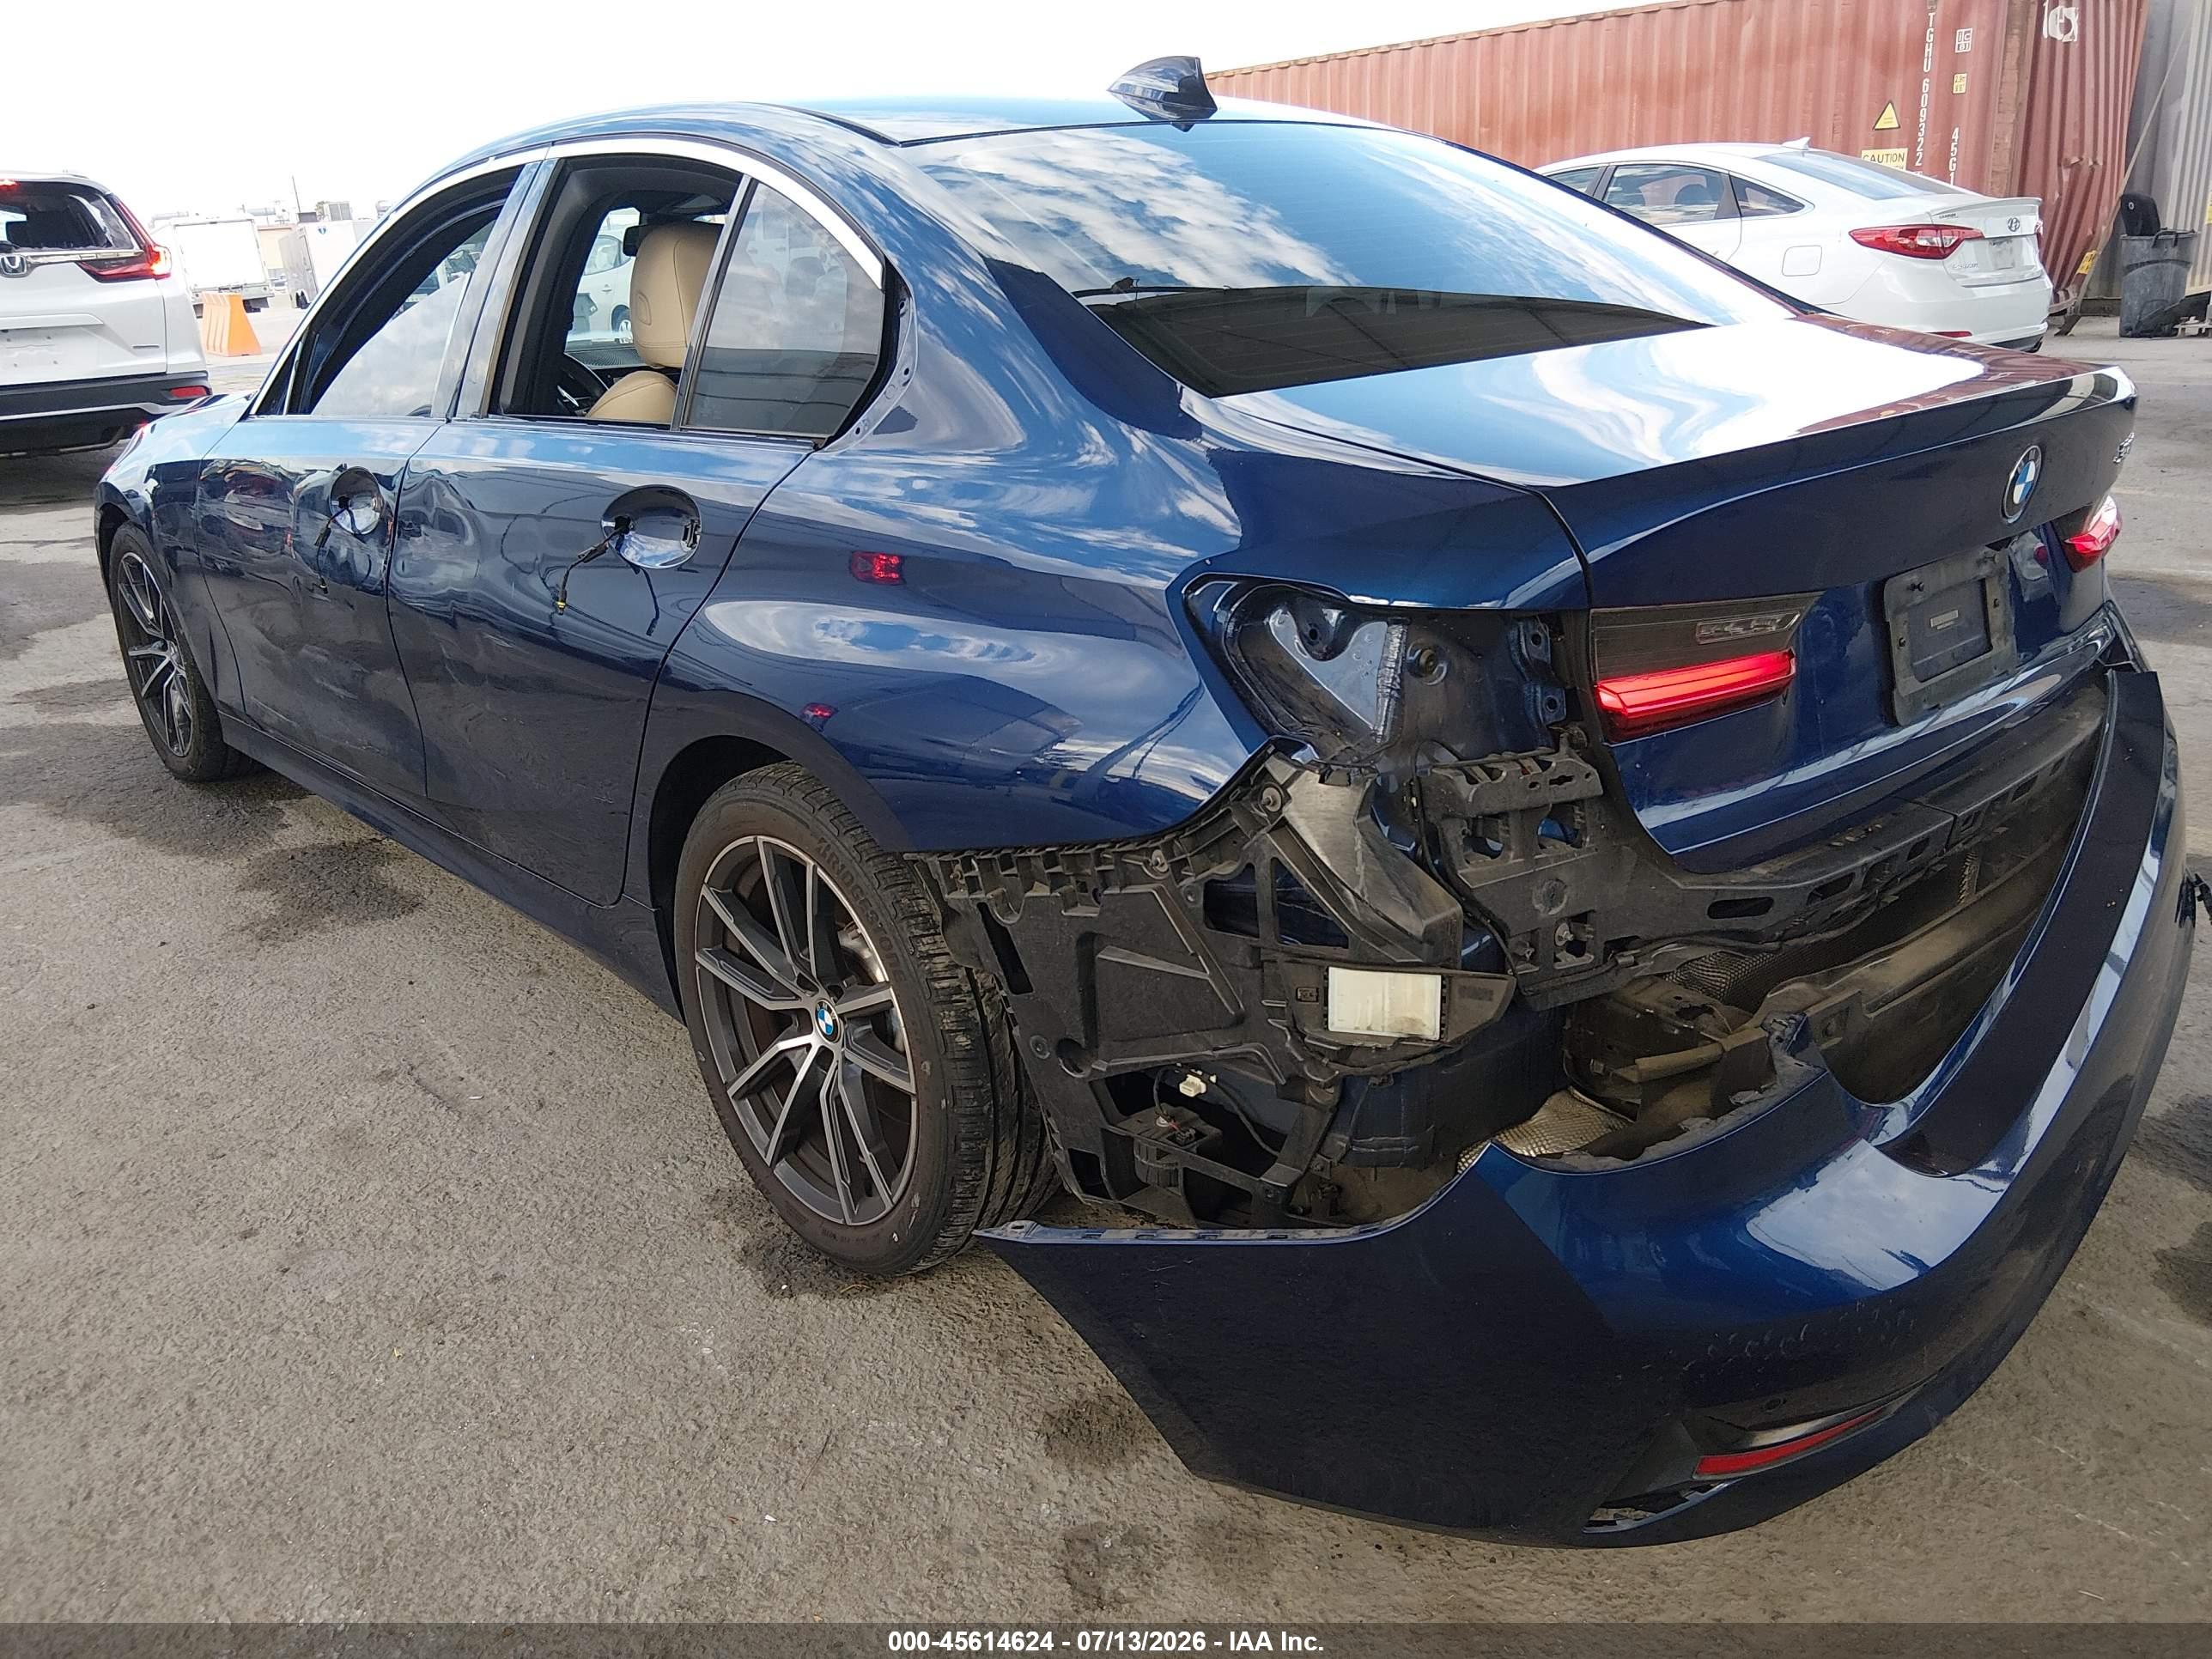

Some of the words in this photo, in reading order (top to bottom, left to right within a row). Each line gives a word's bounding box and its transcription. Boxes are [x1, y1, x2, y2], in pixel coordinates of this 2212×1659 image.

[1923, 12, 1936, 72] TGHU
[1915, 78, 1930, 167] 609322
[1948, 127, 1960, 186] 45G1
